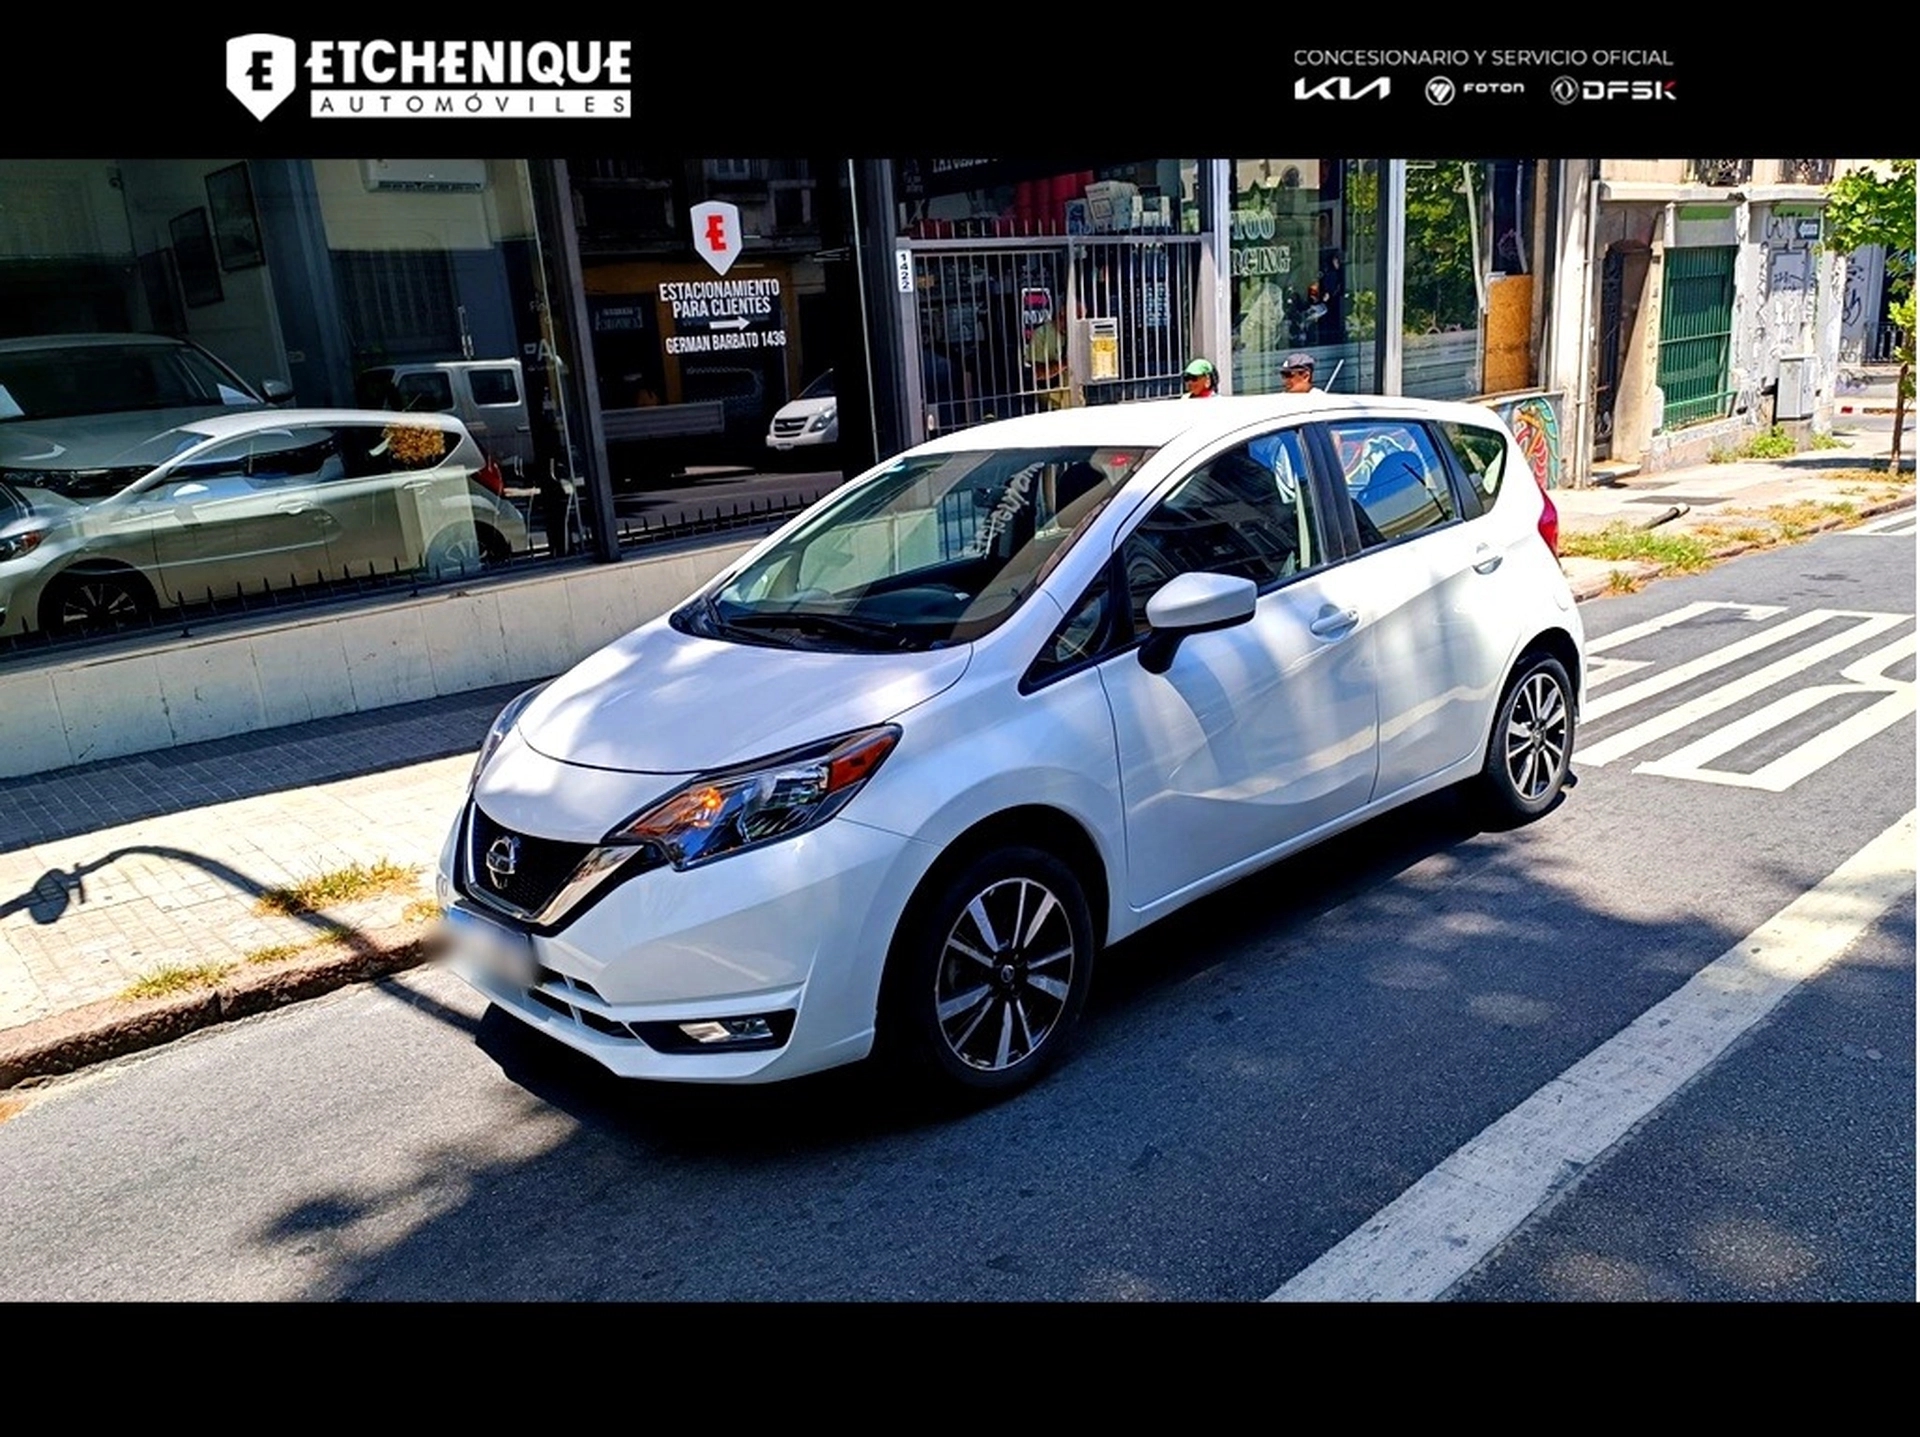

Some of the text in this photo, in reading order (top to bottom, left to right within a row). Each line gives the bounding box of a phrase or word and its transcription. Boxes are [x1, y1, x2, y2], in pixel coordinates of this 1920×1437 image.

[659, 278, 781, 302] ESTACIONAMIENTO
[672, 296, 772, 319] PARA CLIENTES
[665, 334, 711, 355] GERMAN
[711, 331, 759, 351] BARBATO
